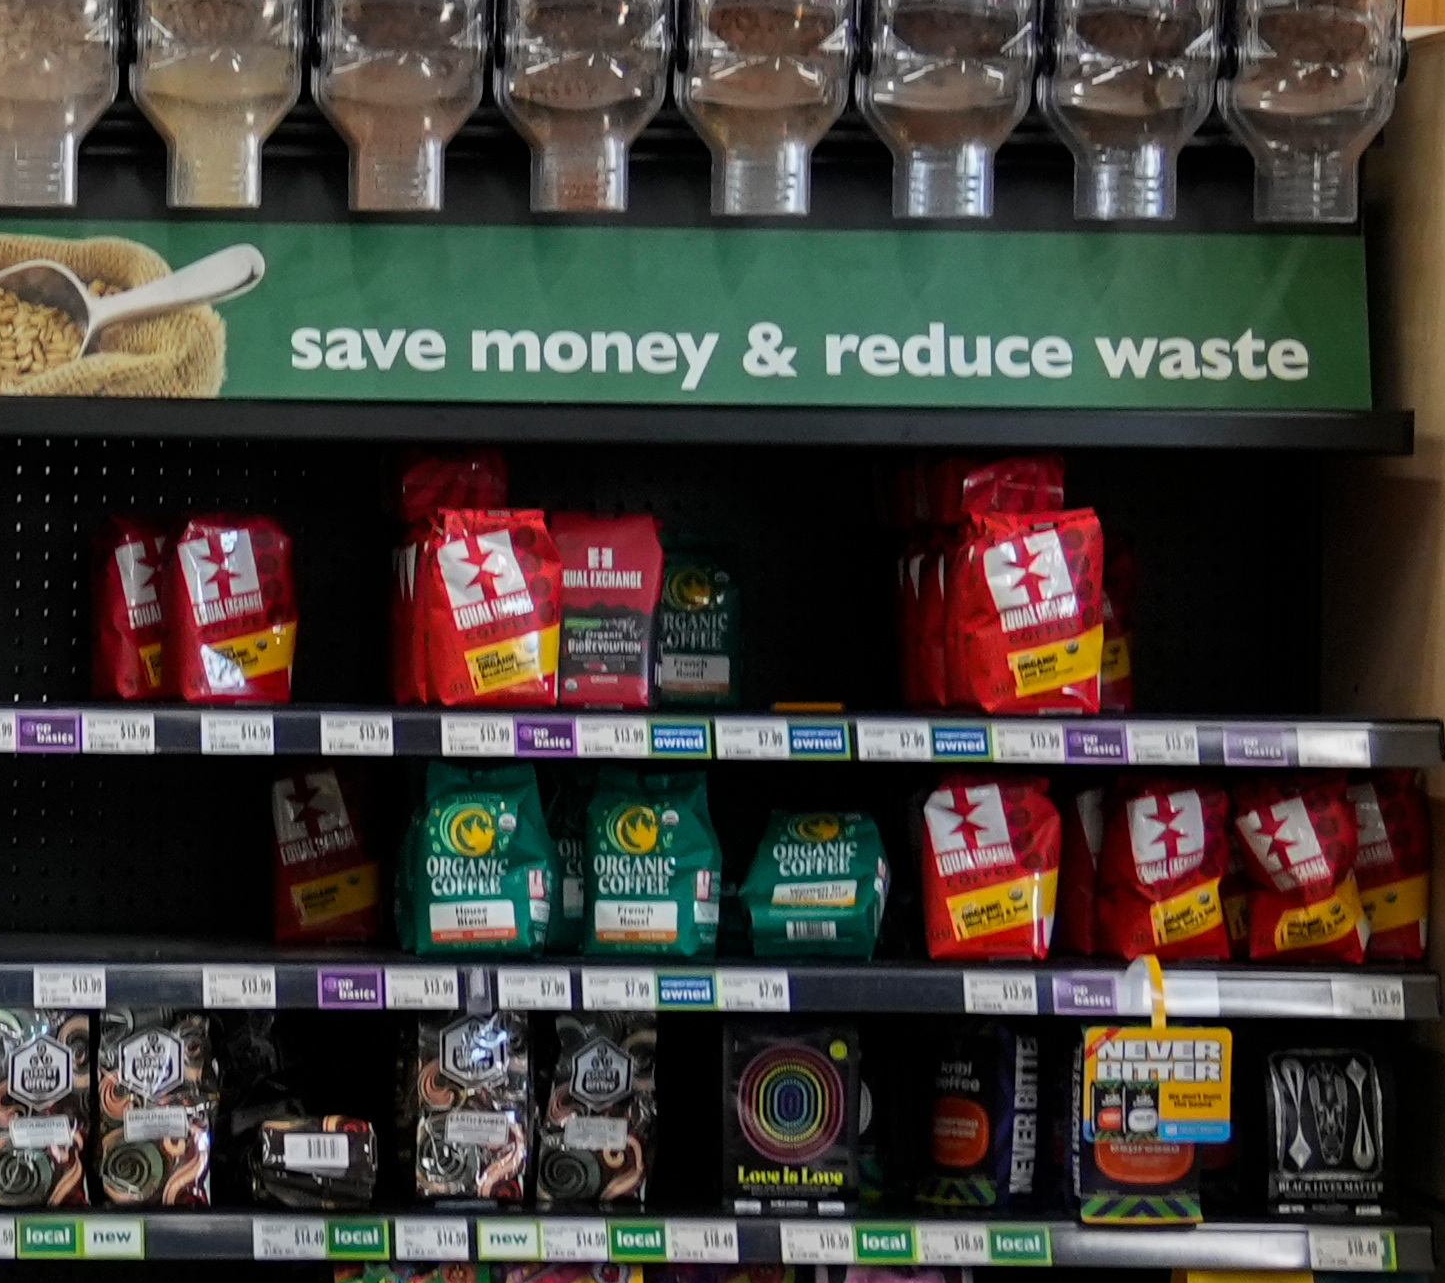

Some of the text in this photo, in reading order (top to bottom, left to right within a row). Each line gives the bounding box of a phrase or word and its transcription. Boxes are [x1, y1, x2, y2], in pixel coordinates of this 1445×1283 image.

[291, 322, 1309, 391] save money & reduce waste
[563, 570, 642, 589] QUAL EXCHANGE
[654, 736, 704, 750] owned
[793, 736, 843, 750] owned
[426, 858, 509, 877] ORGANIC
[593, 855, 675, 877] ORGANIC
[432, 876, 501, 895] COFFEE
[598, 876, 669, 894] COFFEE
[625, 980, 650, 997] $7.99
[1096, 1039, 1222, 1061] NEVER
[1096, 1060, 1222, 1081] BITTER
[738, 1165, 780, 1184] Love
[802, 1166, 844, 1186] Love
[1278, 1182, 1312, 1192] BLACK
[1344, 1181, 1384, 1192] MATTER
[26, 1227, 71, 1244] local
[92, 1230, 131, 1244] new
[334, 1227, 380, 1244] local
[489, 1232, 528, 1245] new
[615, 1229, 662, 1247] local
[861, 1233, 907, 1251] local
[996, 1234, 1041, 1253] local
